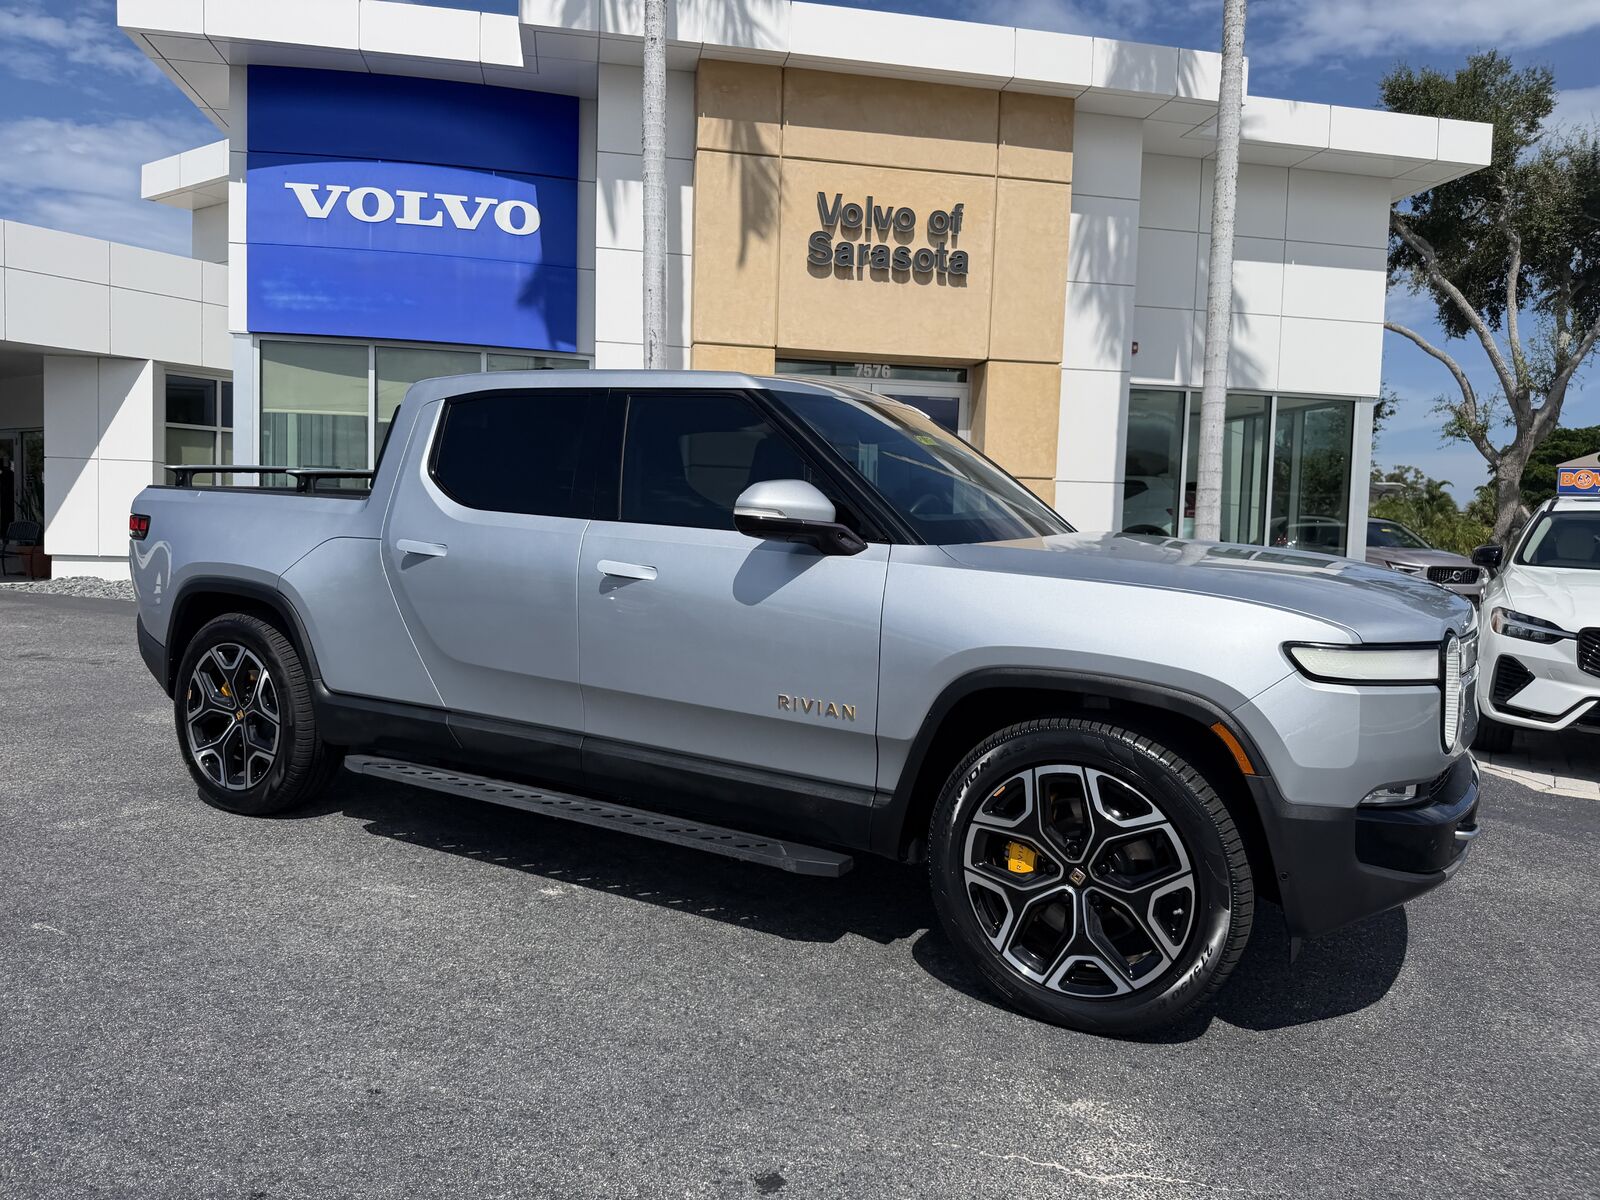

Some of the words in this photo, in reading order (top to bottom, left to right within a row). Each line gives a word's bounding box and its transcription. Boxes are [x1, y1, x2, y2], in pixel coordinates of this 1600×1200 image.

[284, 182, 541, 236] VOLVO
[817, 191, 916, 233] Volvo
[928, 203, 965, 235] of
[808, 230, 969, 275] Sarasota
[854, 363, 891, 378] 7576
[777, 693, 856, 722] RIVIAN
